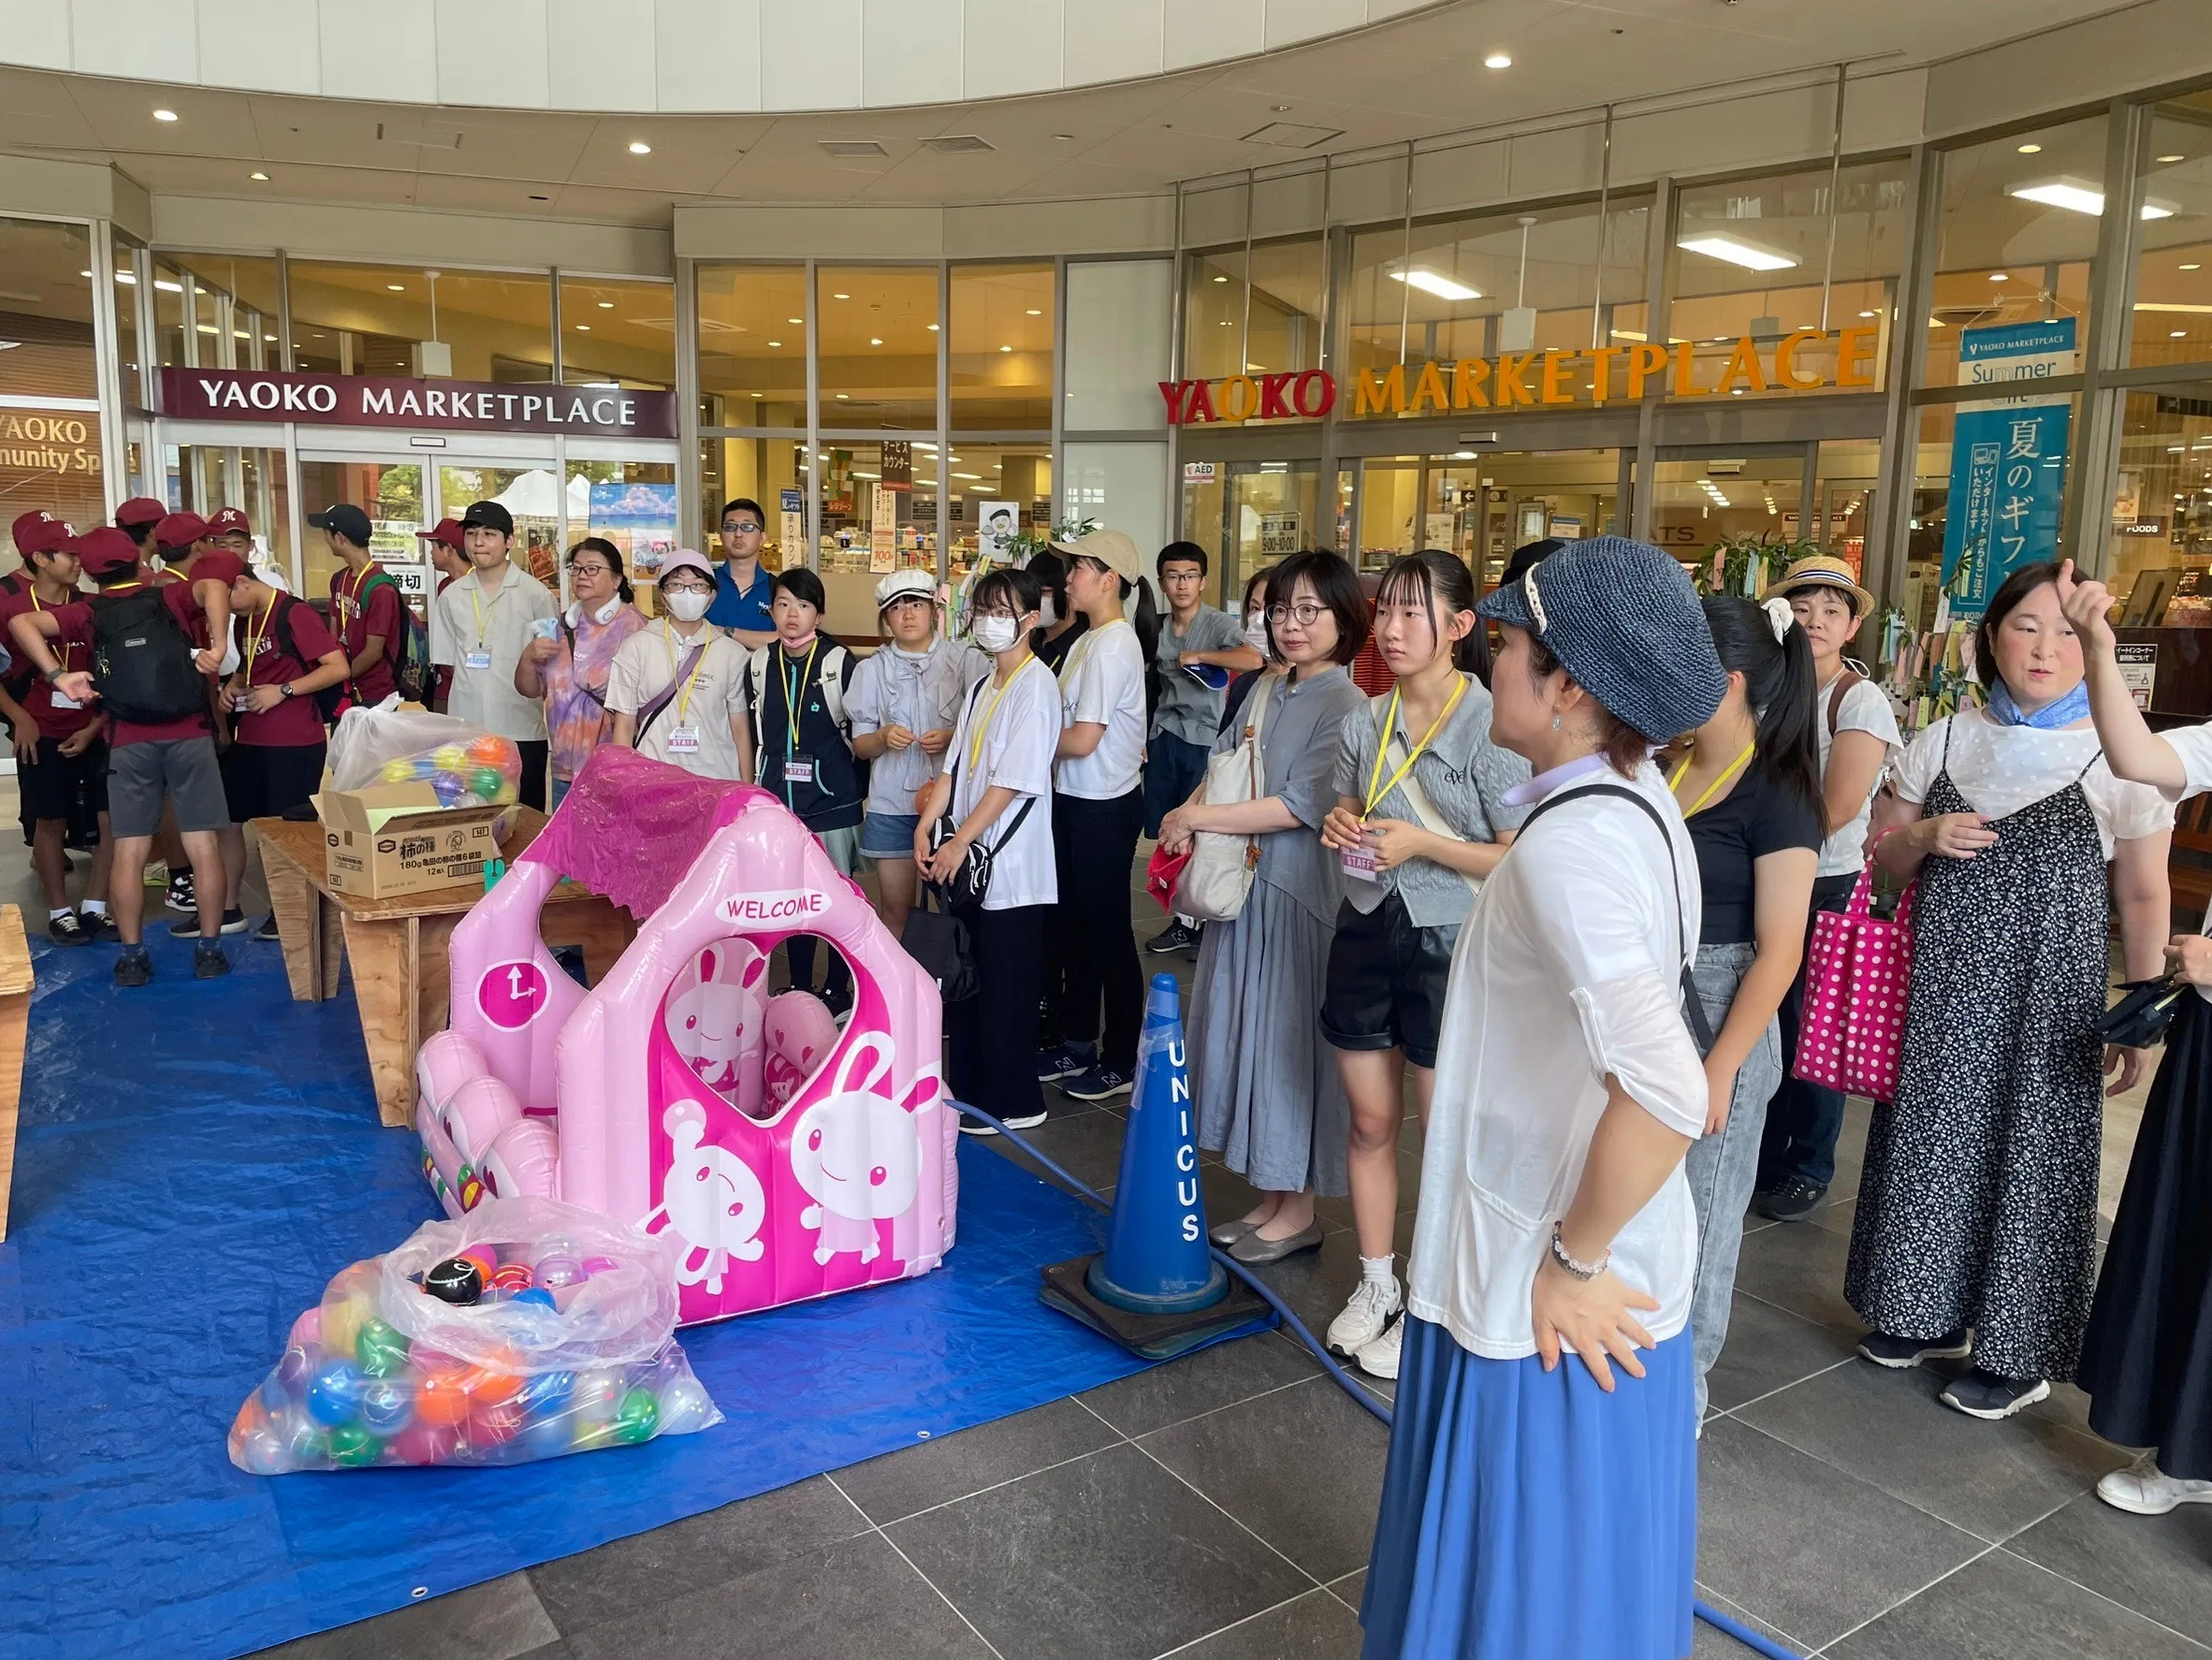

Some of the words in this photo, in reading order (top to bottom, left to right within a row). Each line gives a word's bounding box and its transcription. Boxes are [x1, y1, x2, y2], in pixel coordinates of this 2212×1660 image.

[1979, 342, 2004, 352] YAOKO
[2006, 335, 2064, 349] MARKETPLACE
[1157, 368, 1338, 426] YAOKO
[1354, 326, 1879, 416] MARKETPLACE
[1972, 361, 2057, 384] Summer
[199, 379, 338, 414] YAOKO
[361, 386, 636, 427] MARKETPLACE
[1194, 465, 1213, 473] AED
[1346, 855, 1373, 870] STAFF
[727, 894, 822, 919] WELCOME
[1168, 1039, 1201, 1243] UNICUS
